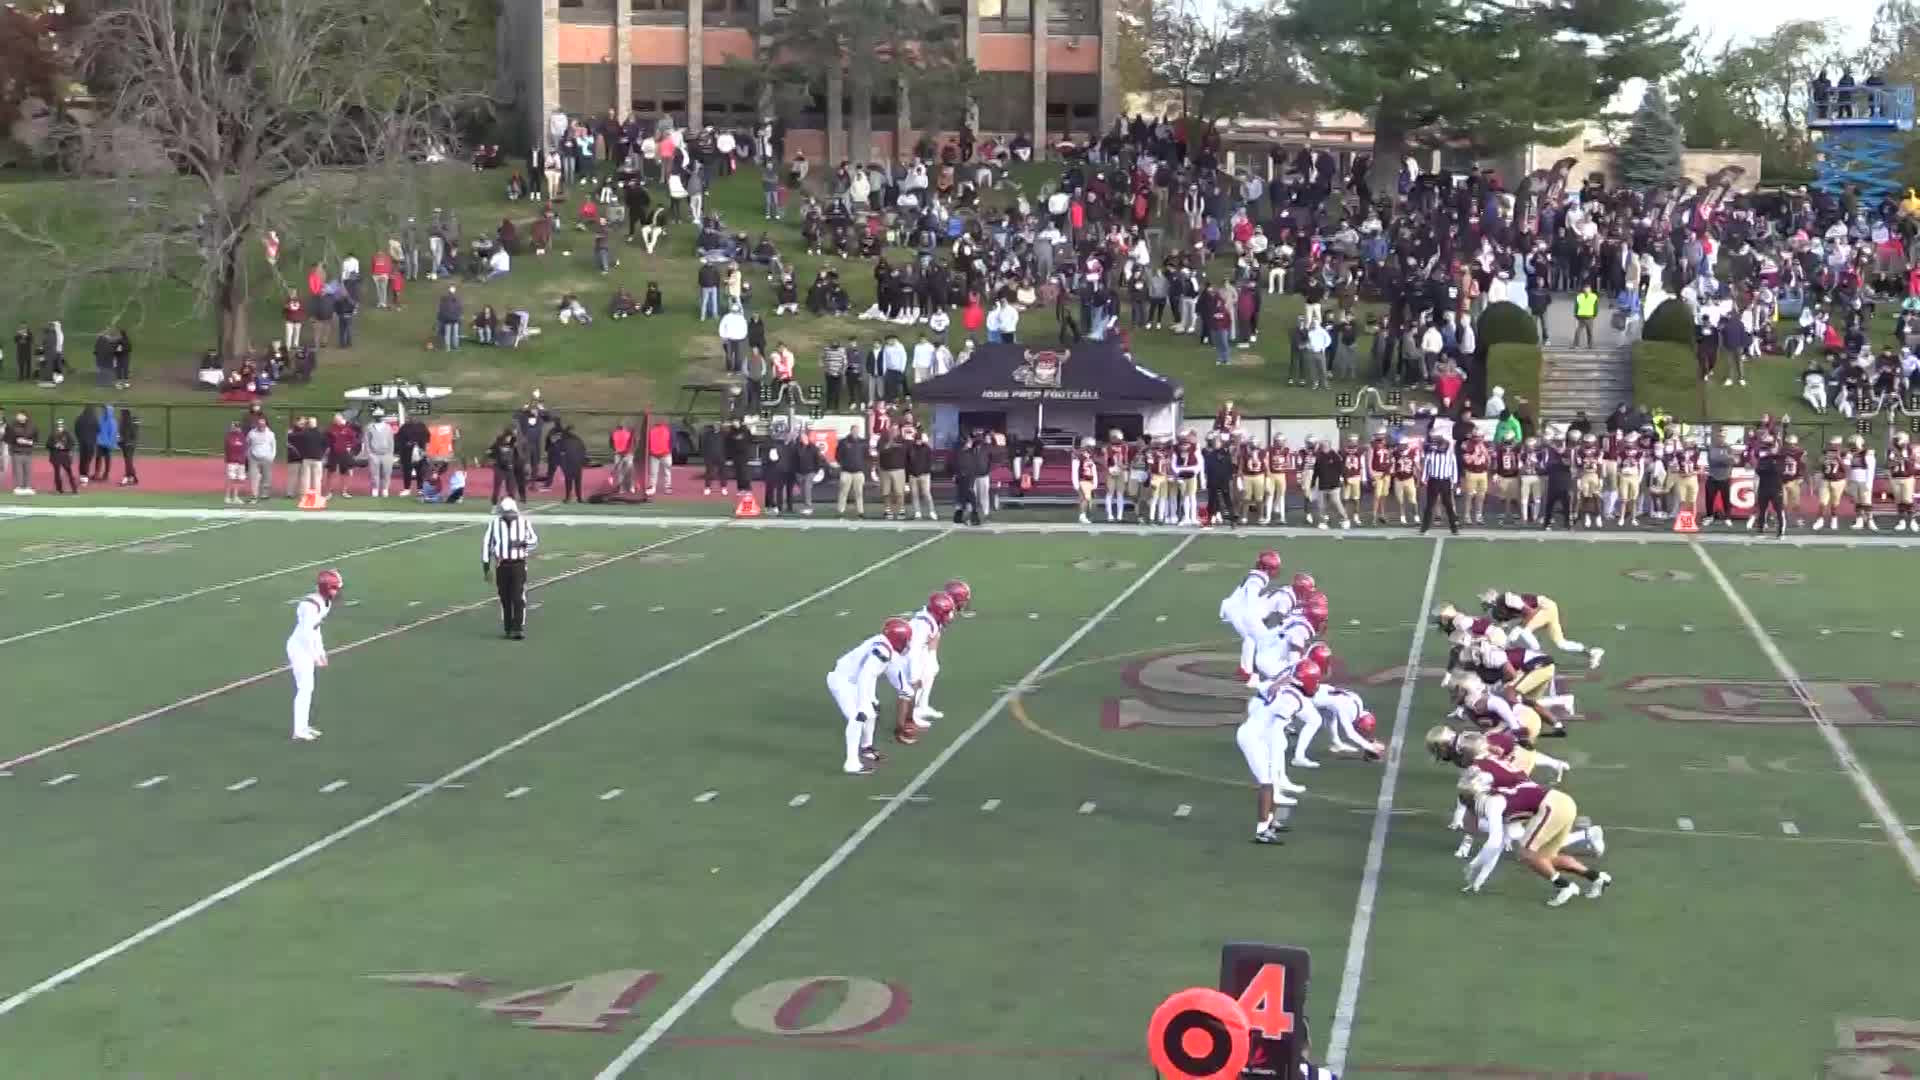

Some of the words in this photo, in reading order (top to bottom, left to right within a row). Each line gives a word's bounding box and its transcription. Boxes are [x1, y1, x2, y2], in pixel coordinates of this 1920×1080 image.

[1012, 391, 1041, 399] PREP
[1043, 391, 1099, 399] FOOTBALL
[1729, 480, 1755, 509] G
[1238, 963, 1294, 1040] 4
